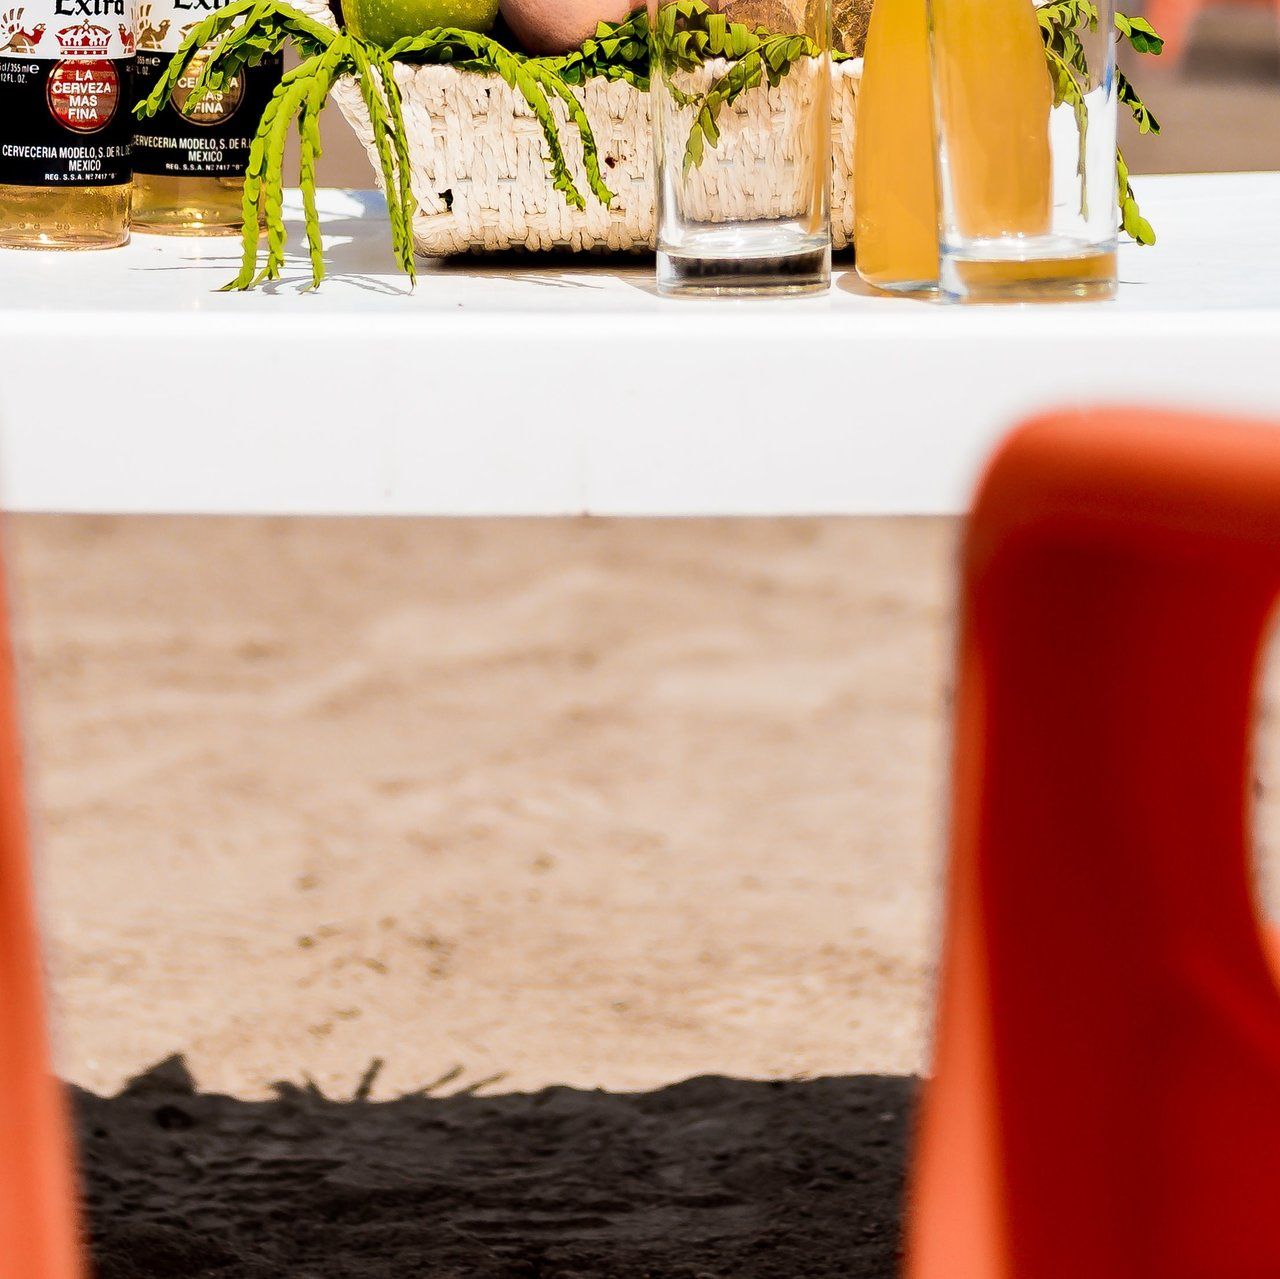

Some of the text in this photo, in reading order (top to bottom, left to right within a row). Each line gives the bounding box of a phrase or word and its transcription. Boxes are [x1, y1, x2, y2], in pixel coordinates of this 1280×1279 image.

[75, 69, 93, 81] LA
[52, 81, 111, 94] CERVEZA
[69, 95, 98, 107] MAS
[68, 108, 98, 120] FINA
[193, 102, 224, 114] FINA
[179, 138, 219, 151] MODELO,
[229, 138, 240, 150] DE
[2, 144, 58, 159] CERVECERIA
[59, 146, 98, 160] MODELO,
[106, 146, 115, 158] DE
[188, 150, 223, 162] MEXICO
[68, 159, 101, 172] MEXICO
[44, 173, 61, 181] REG.
